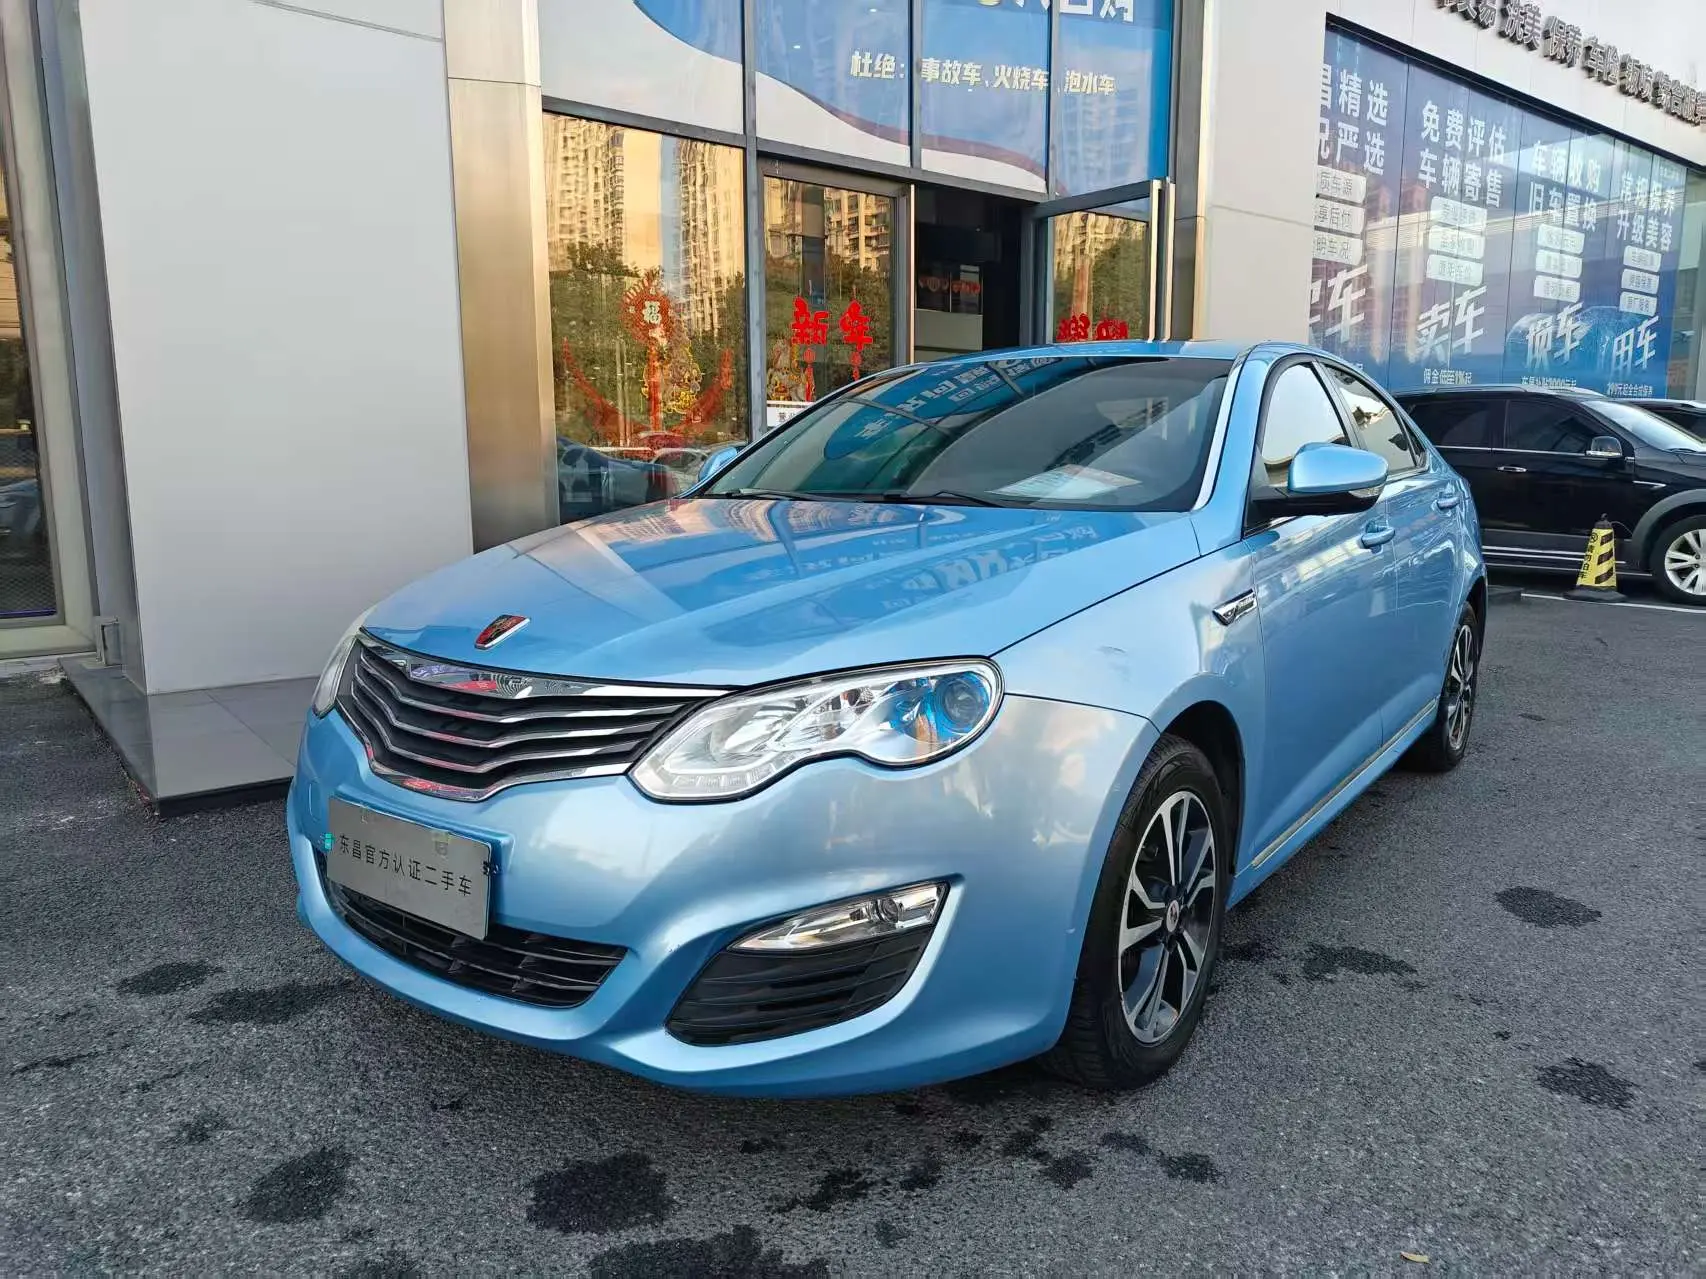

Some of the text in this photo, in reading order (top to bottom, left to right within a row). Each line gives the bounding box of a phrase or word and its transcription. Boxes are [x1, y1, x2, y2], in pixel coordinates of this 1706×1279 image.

[1545, 16, 1582, 67] 保养
[1654, 71, 1706, 125] 综合服
[1421, 99, 1507, 165] 免费评估
[1318, 170, 1354, 198] 质车源
[1418, 147, 1502, 208] 车辆寄售
[1528, 181, 1597, 233] 旧车置换
[1313, 235, 1350, 261] 明车况
[1616, 208, 1673, 252] 升级美容
[790, 294, 874, 352] 新年
[1415, 285, 1487, 366] 卖车
[1610, 315, 1659, 378] 用车
[339, 834, 473, 896] 东昌官方认证二手车
